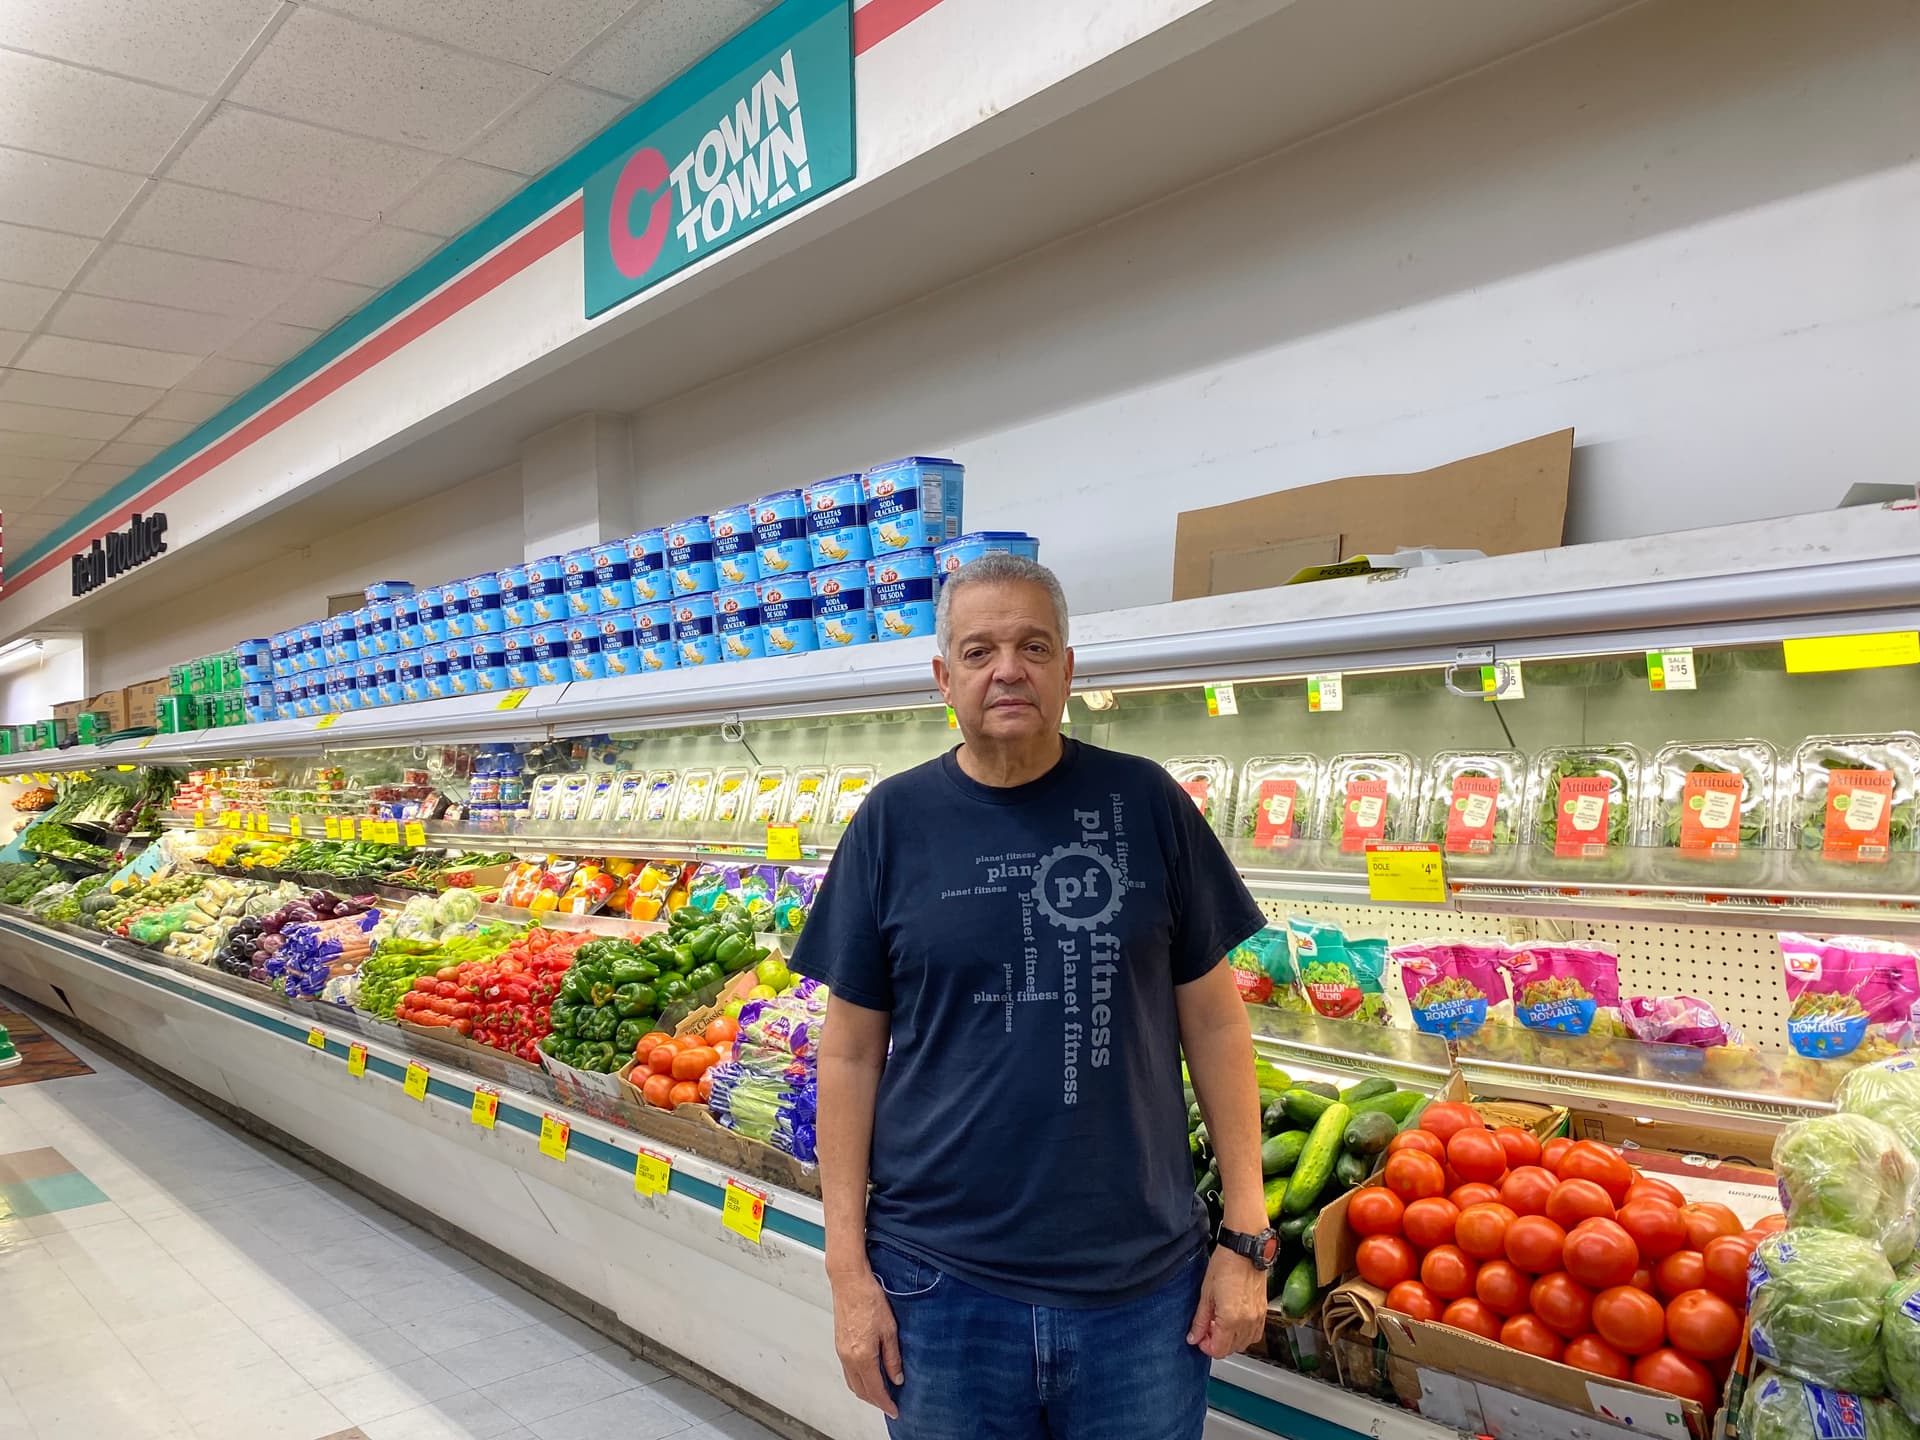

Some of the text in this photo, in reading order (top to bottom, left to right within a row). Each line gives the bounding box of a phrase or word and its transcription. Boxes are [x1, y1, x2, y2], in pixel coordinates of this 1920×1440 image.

[609, 49, 799, 279] C TOWN
[813, 509, 841, 520] GALLETAS
[824, 517, 840, 525] SODA
[757, 522, 782, 532] GALLETAS
[877, 583, 906, 593] GALLETAS
[888, 591, 904, 600] SODA
[1456, 781, 1497, 792] Attitude
[1688, 775, 1740, 788] Attitude
[1831, 774, 1890, 786] Attitude
[1562, 782, 1608, 793] Attitude
[1110, 793, 1124, 836] planet
[976, 852, 1036, 864] planet fitness
[941, 886, 1007, 899] planet fitness
[1055, 867, 1100, 908] pf
[1019, 892, 1034, 942] planet
[1311, 983, 1345, 993] ITALIAN
[974, 991, 1058, 1004] planet fitness
[1090, 933, 1121, 1068] fitness
[1316, 992, 1341, 1000] BLEND
[1429, 999, 1466, 1012] CLASSIC
[1534, 998, 1573, 1012] CLASSIC
[1424, 1005, 1473, 1021] ROMAINE
[1058, 939, 1082, 1105] planet fitness
[1792, 1022, 1847, 1033] ROMAINE
[1717, 1097, 1754, 1110] SMART
[1757, 1103, 1794, 1115] VALUE
